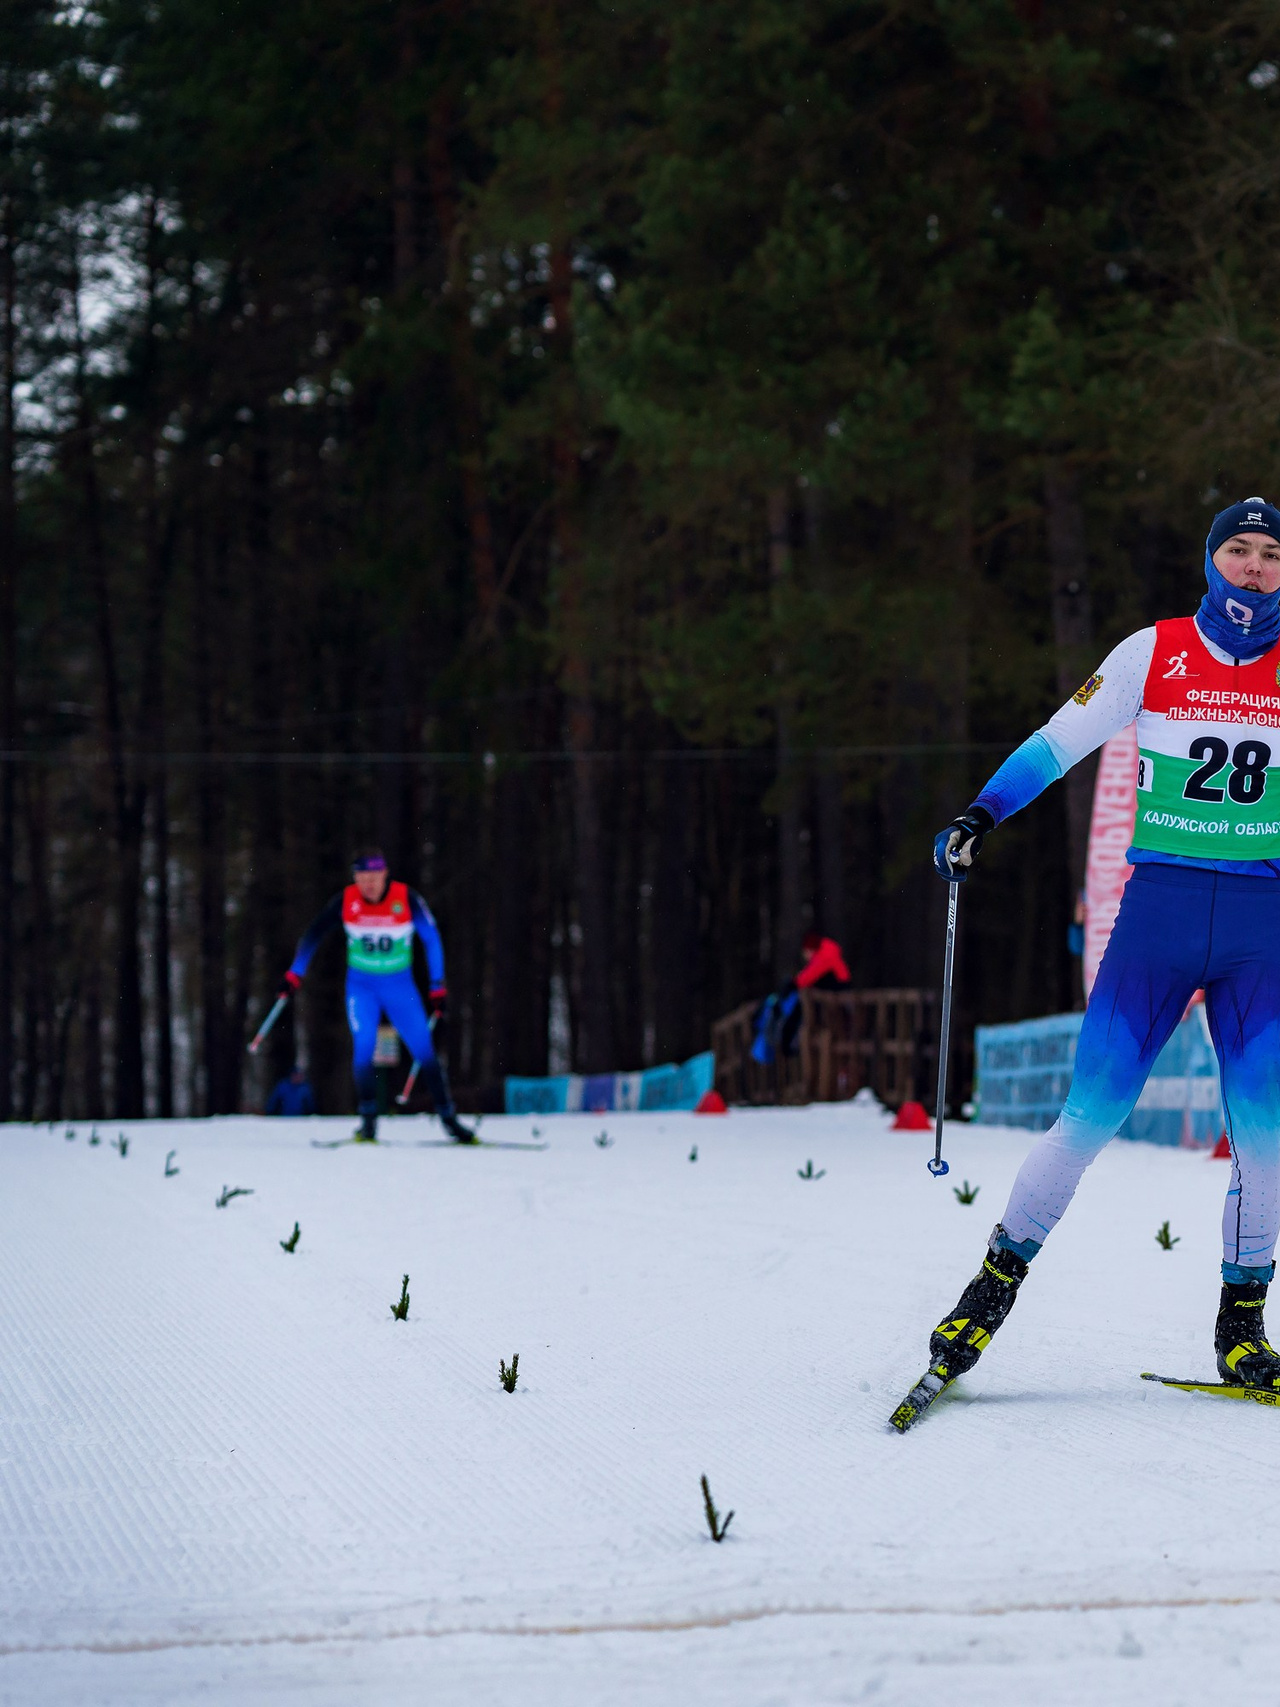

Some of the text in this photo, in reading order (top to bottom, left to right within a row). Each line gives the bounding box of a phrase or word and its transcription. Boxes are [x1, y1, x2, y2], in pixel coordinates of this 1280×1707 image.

[1186, 689, 1280, 709] ФЕДЕРАЦИЯ
[1167, 707, 1243, 724] ЛЫЖНЫХ
[1183, 736, 1272, 804] 28
[1143, 810, 1229, 834] КАЛУЖСКОЙ
